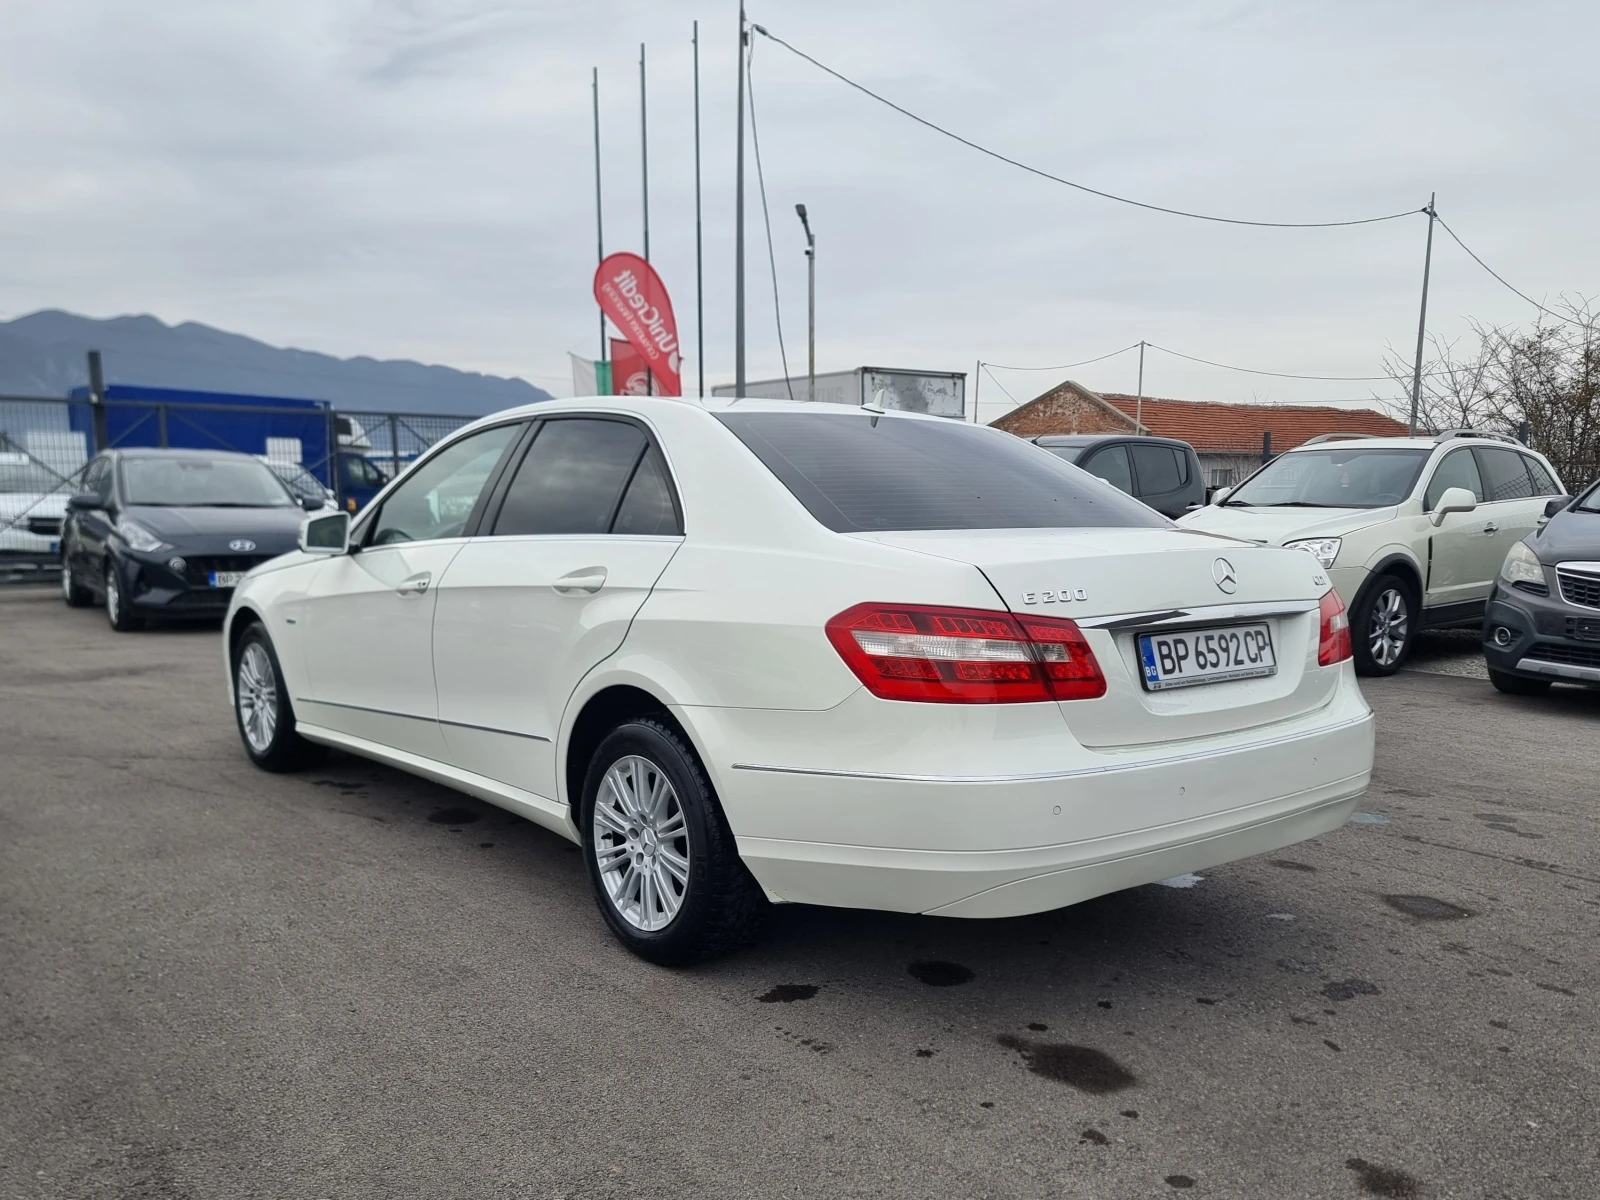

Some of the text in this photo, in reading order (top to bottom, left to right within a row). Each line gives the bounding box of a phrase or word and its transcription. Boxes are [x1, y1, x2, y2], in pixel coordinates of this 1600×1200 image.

[1022, 588, 1088, 605] E 200
[1157, 638, 1189, 676] BP
[1194, 633, 1244, 670] 6592
[1244, 630, 1266, 663] CP
[1145, 666, 1157, 677] BG
